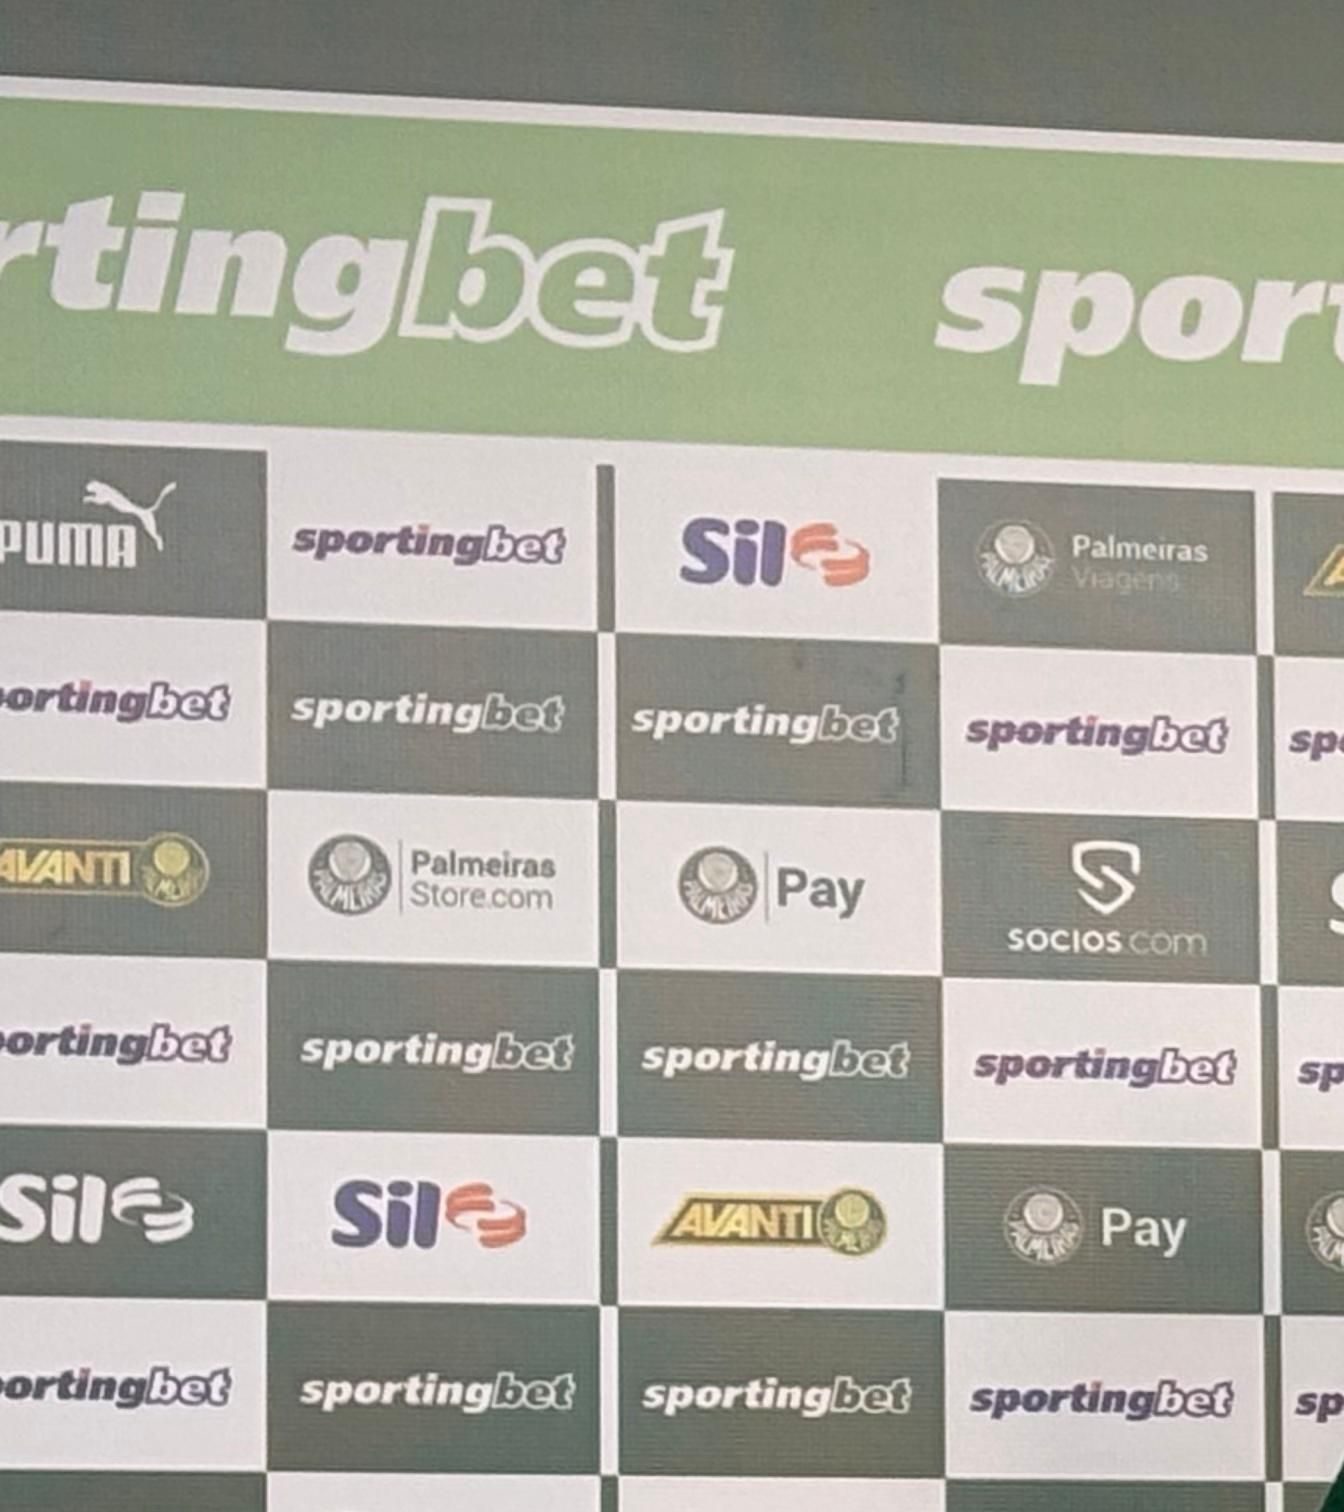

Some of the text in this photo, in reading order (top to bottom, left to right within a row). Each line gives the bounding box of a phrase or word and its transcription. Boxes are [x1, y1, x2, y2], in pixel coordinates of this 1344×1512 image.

[293, 525, 566, 566] sportingbet
[680, 518, 786, 587] Sil
[1073, 535, 1208, 562] Palmeiras
[292, 693, 565, 733] sportingbet
[633, 705, 898, 745] sportingbet
[966, 715, 1229, 756] sportingbet
[412, 850, 556, 878] Palmeiras
[410, 880, 553, 909] Store.com
[778, 867, 865, 919] Pay
[0, 1023, 232, 1065] ortingbet
[301, 1032, 574, 1073] sportingbet
[642, 1040, 910, 1081] sportingbet
[975, 1048, 1237, 1088] sportingbet
[0, 1174, 106, 1243] Sil
[332, 1180, 441, 1249] Sil
[674, 1201, 812, 1238] AVANTI
[1103, 1208, 1186, 1257] Pay
[0, 1367, 231, 1409] ortingbet
[300, 1372, 576, 1413] sportingbet
[643, 1376, 912, 1417] sportingbet
[970, 1380, 1234, 1421] sportingbet
